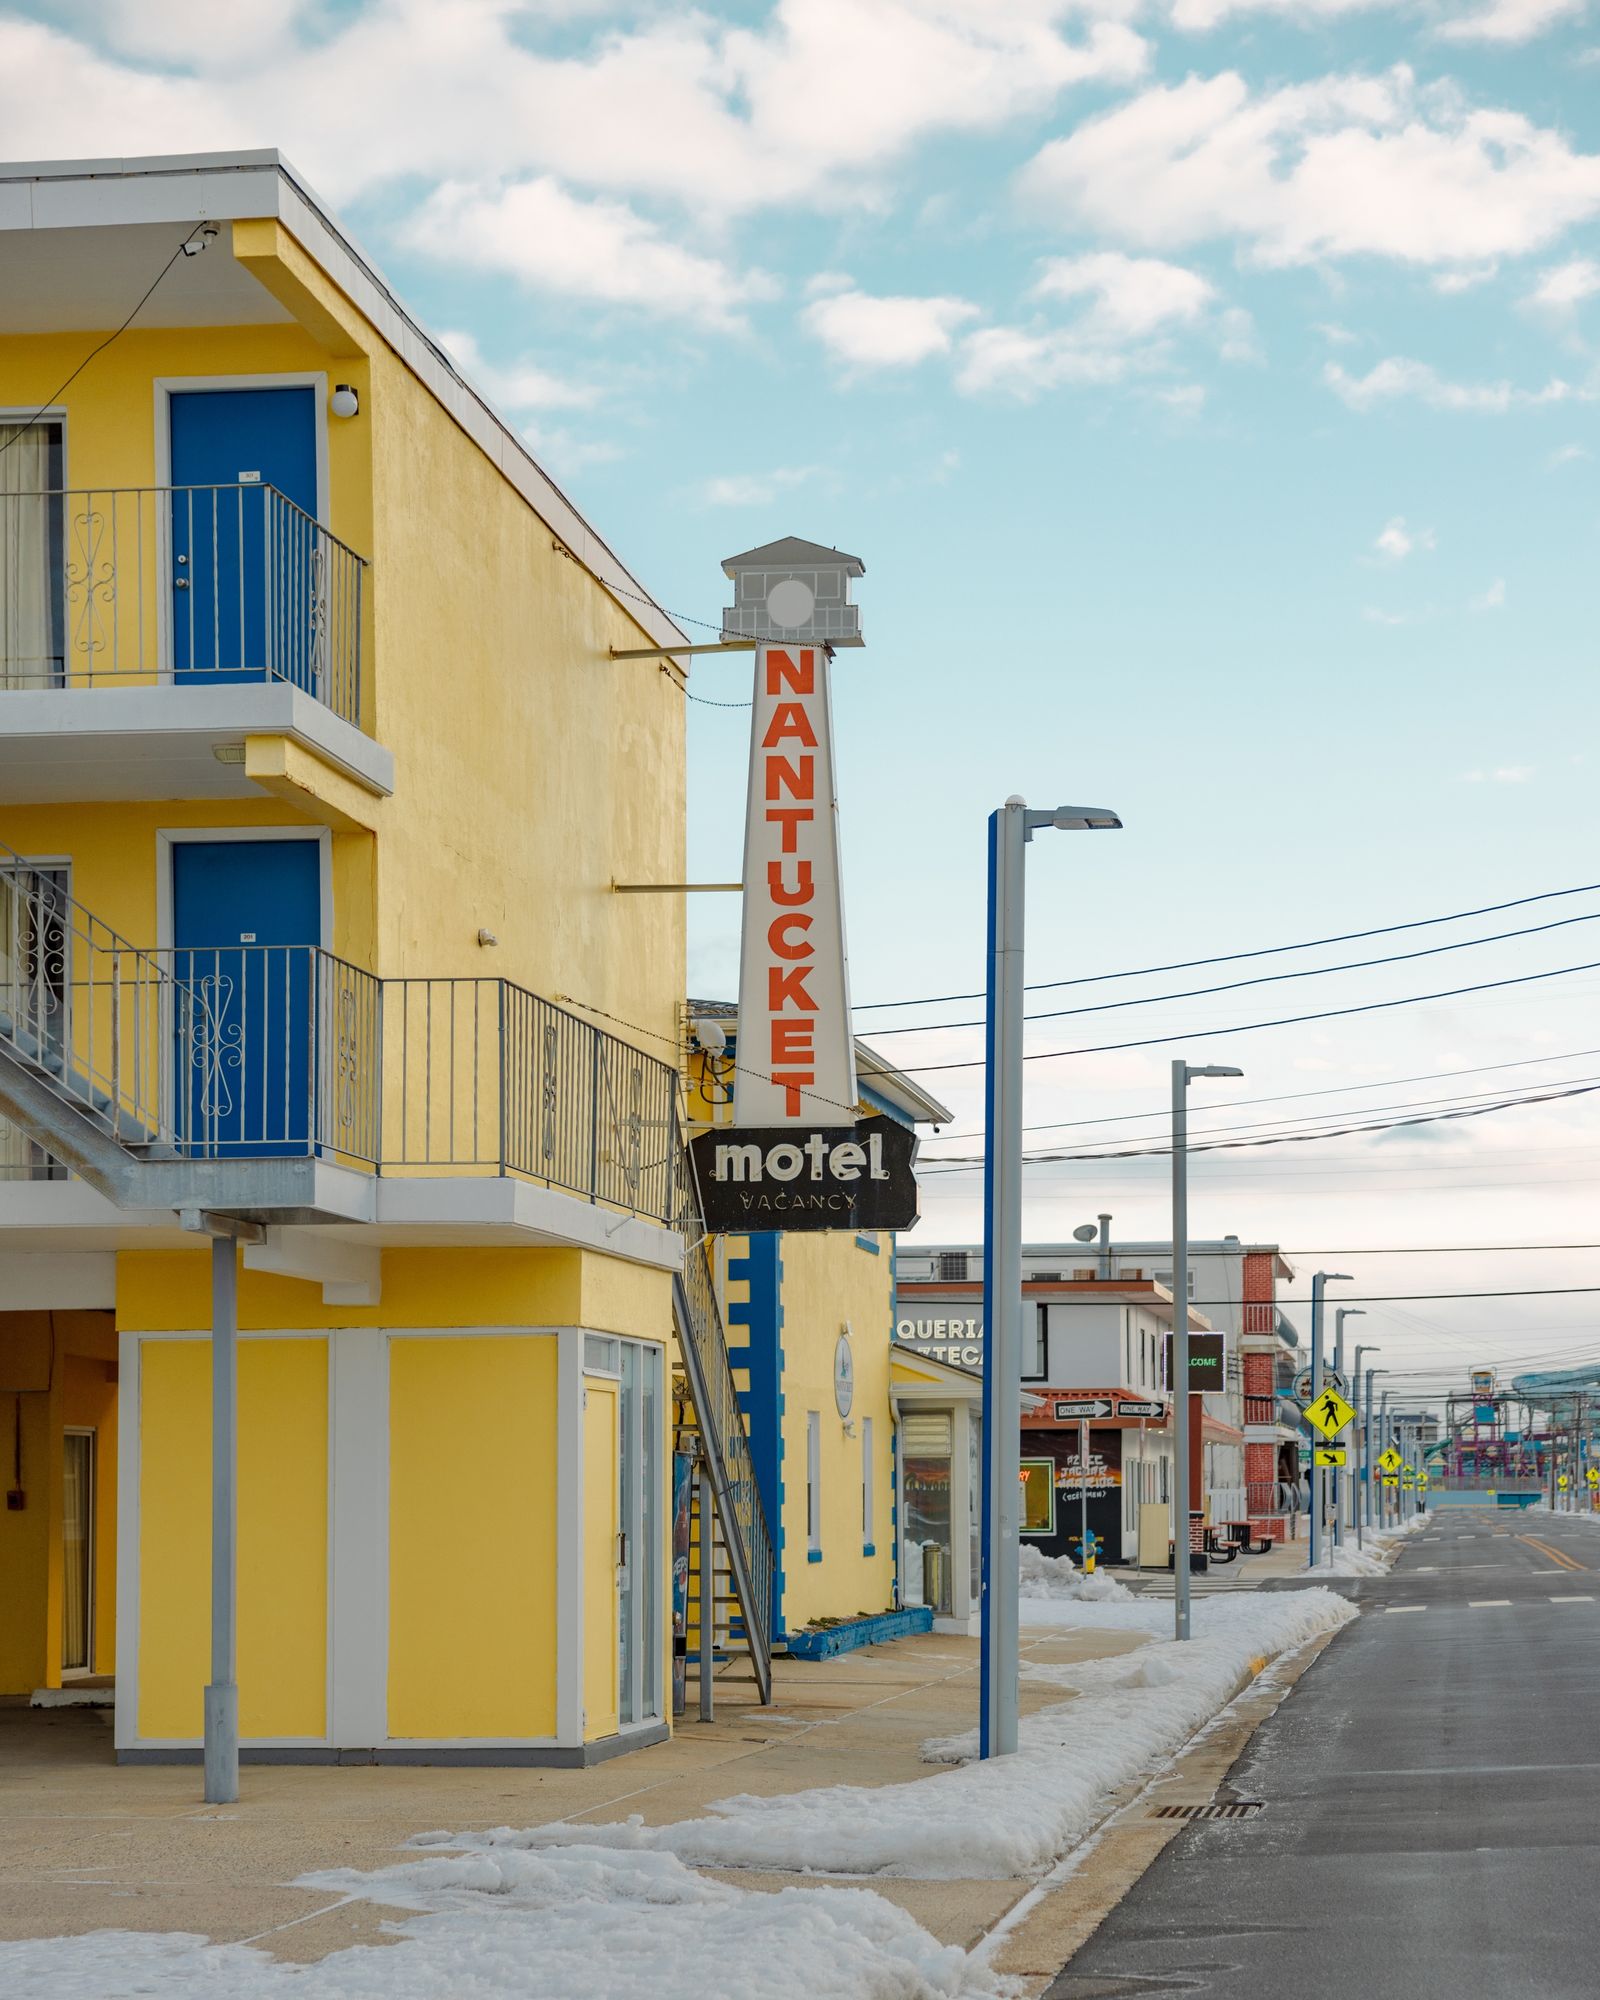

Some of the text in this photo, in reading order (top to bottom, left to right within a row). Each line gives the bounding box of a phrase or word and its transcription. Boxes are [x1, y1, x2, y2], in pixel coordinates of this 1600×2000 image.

[761, 649, 820, 1117] NANTUCKET
[715, 1133, 887, 1182] motel
[739, 1191, 857, 1211] VACANCY
[1067, 1454, 1104, 1466] AZEC
